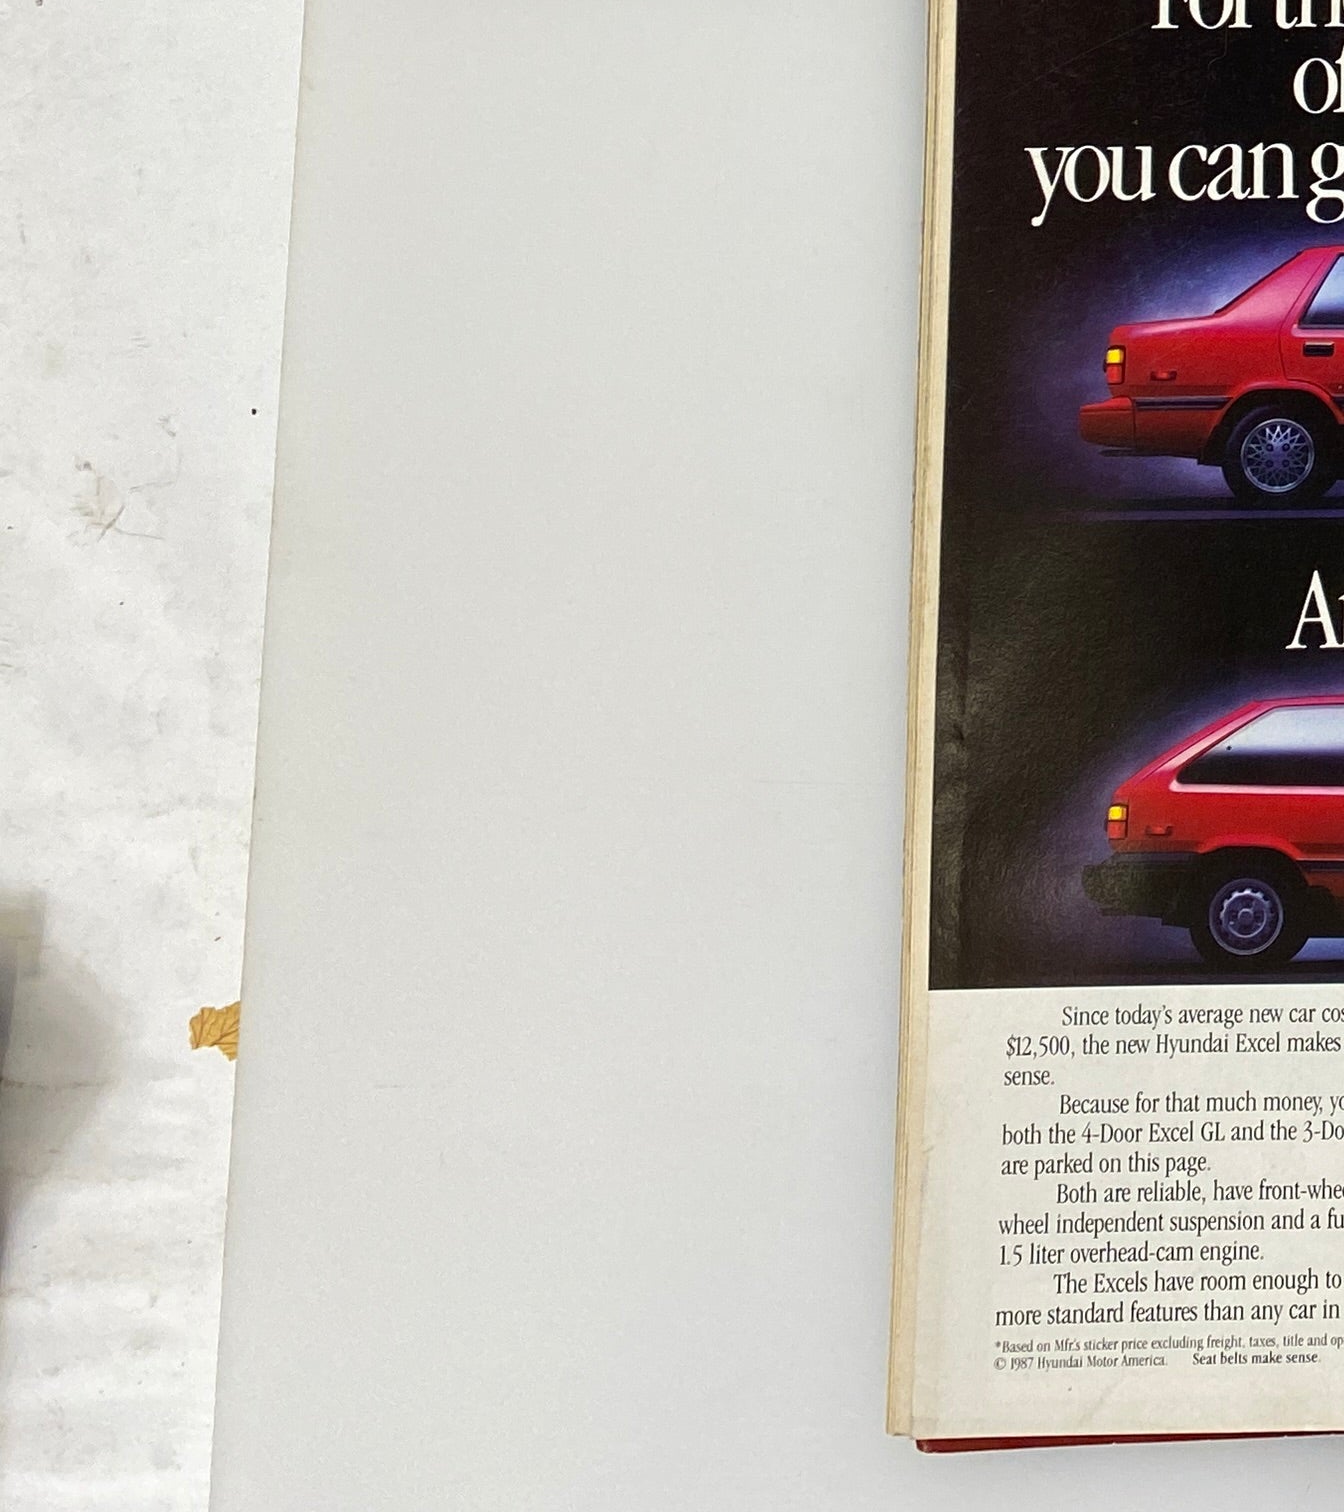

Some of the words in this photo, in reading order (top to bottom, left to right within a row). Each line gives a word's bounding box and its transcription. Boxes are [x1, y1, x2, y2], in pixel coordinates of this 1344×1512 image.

[1024, 146, 1156, 226] you
[1169, 143, 1299, 201] can
[1193, 1353, 1216, 1365] Seat
[1221, 1351, 1247, 1364] belts
[1252, 1351, 1282, 1364] make
